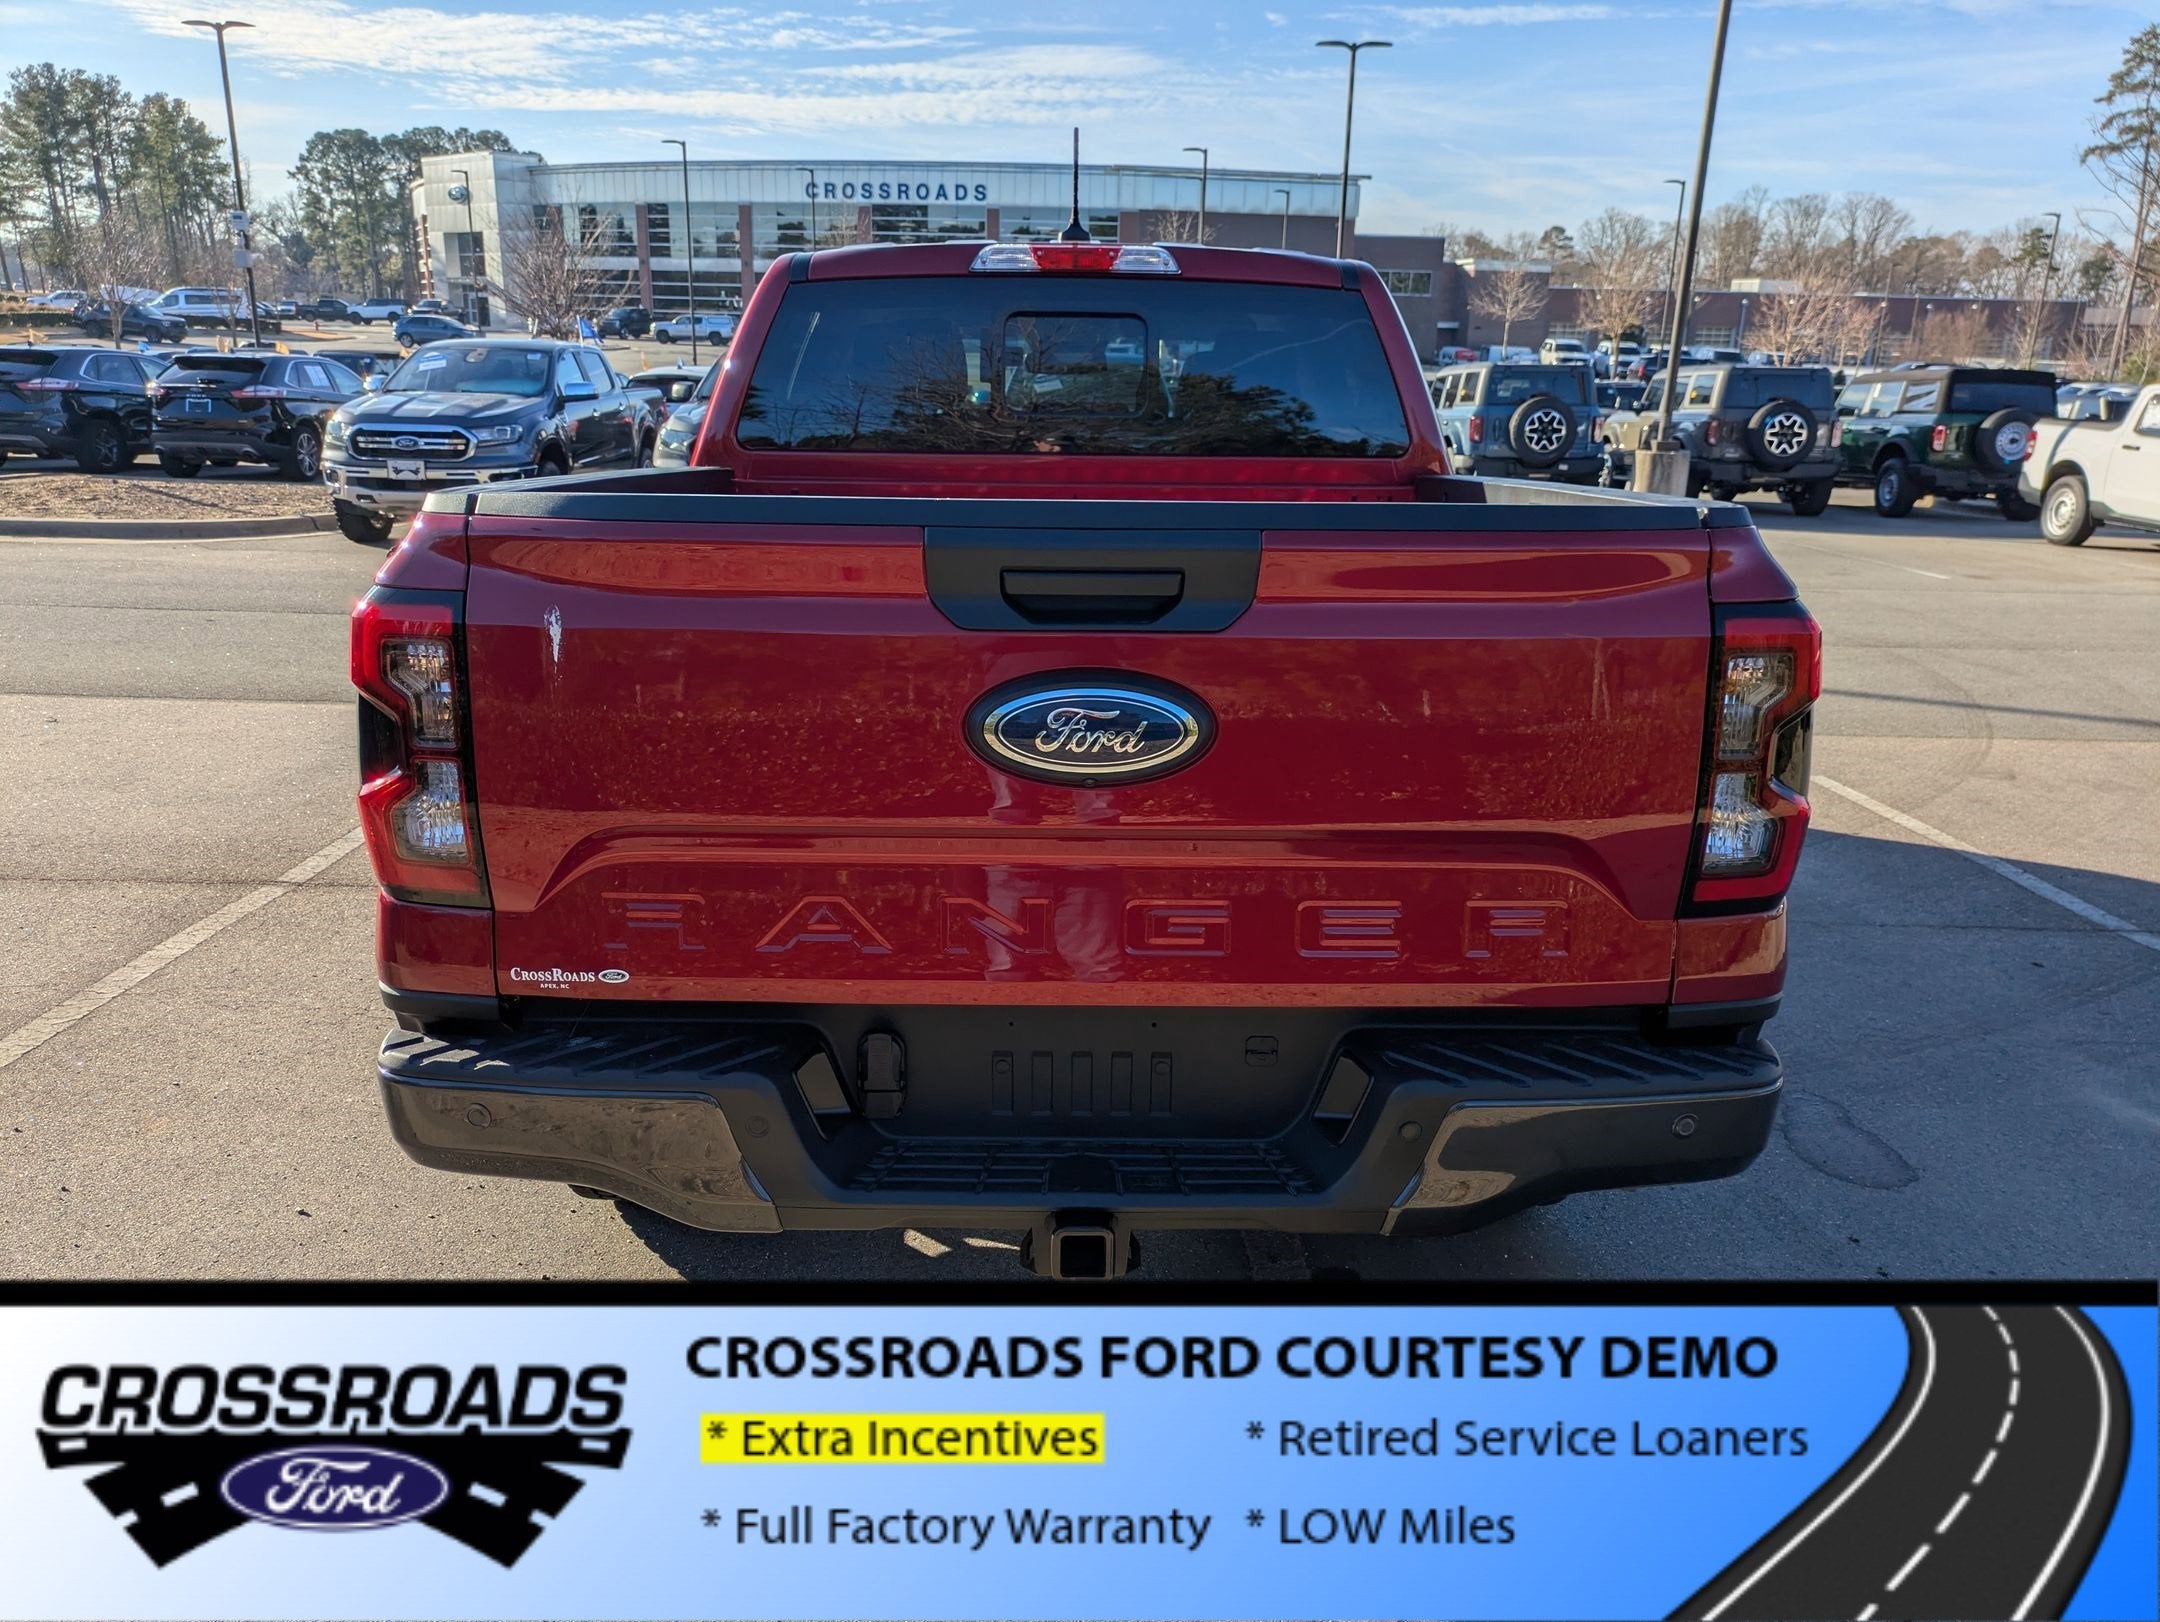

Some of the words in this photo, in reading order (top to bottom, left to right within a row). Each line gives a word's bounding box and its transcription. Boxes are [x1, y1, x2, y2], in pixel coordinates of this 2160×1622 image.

[805, 182, 987, 201] CROSSROADS
[1034, 706, 1149, 754] Ford
[601, 892, 1569, 959] RANGER
